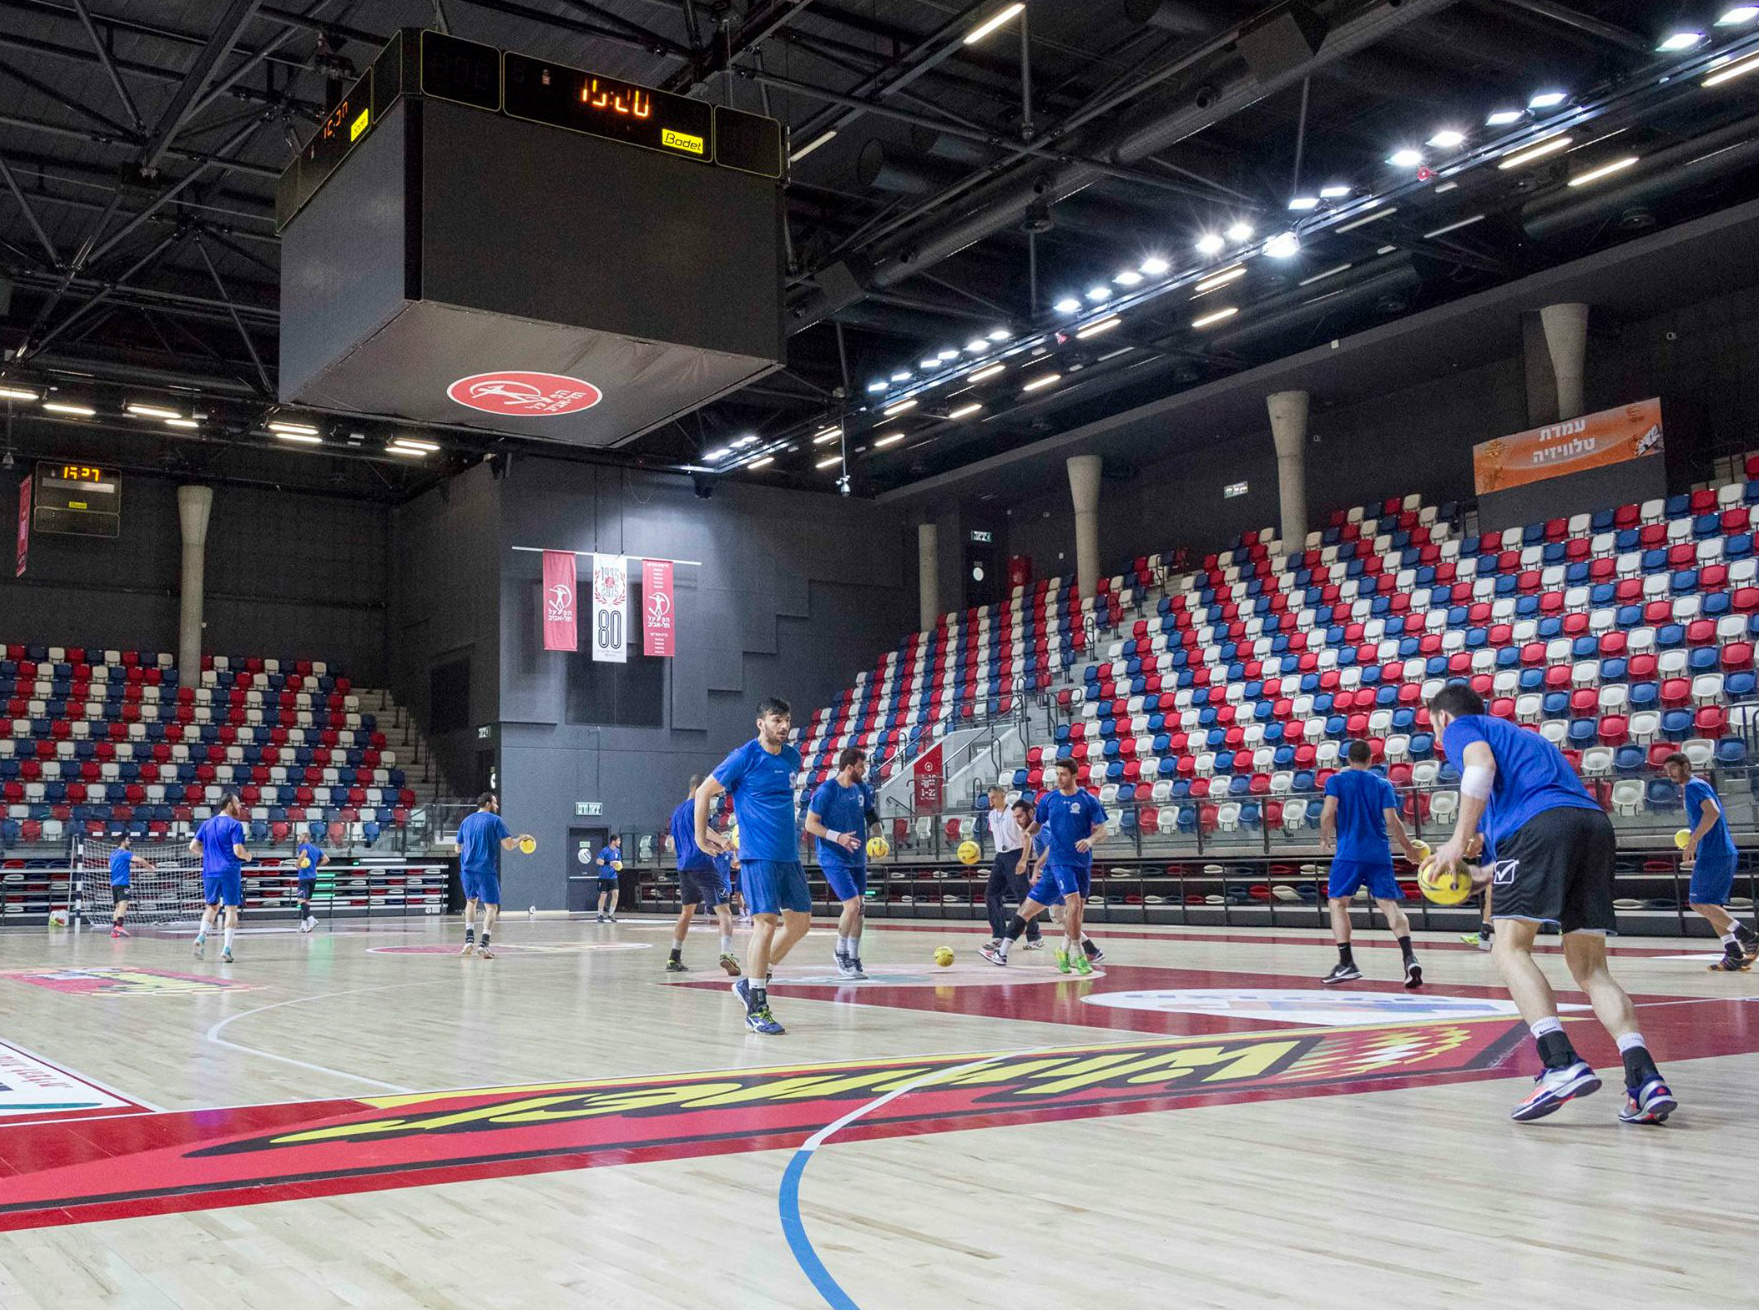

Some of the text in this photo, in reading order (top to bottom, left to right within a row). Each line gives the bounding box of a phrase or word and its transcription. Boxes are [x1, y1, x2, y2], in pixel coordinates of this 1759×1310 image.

[665, 132, 702, 151] Bodet
[1533, 437, 1596, 463] טלוויזיה
[598, 609, 622, 650] 80
[269, 1040, 1301, 1144] Winner
